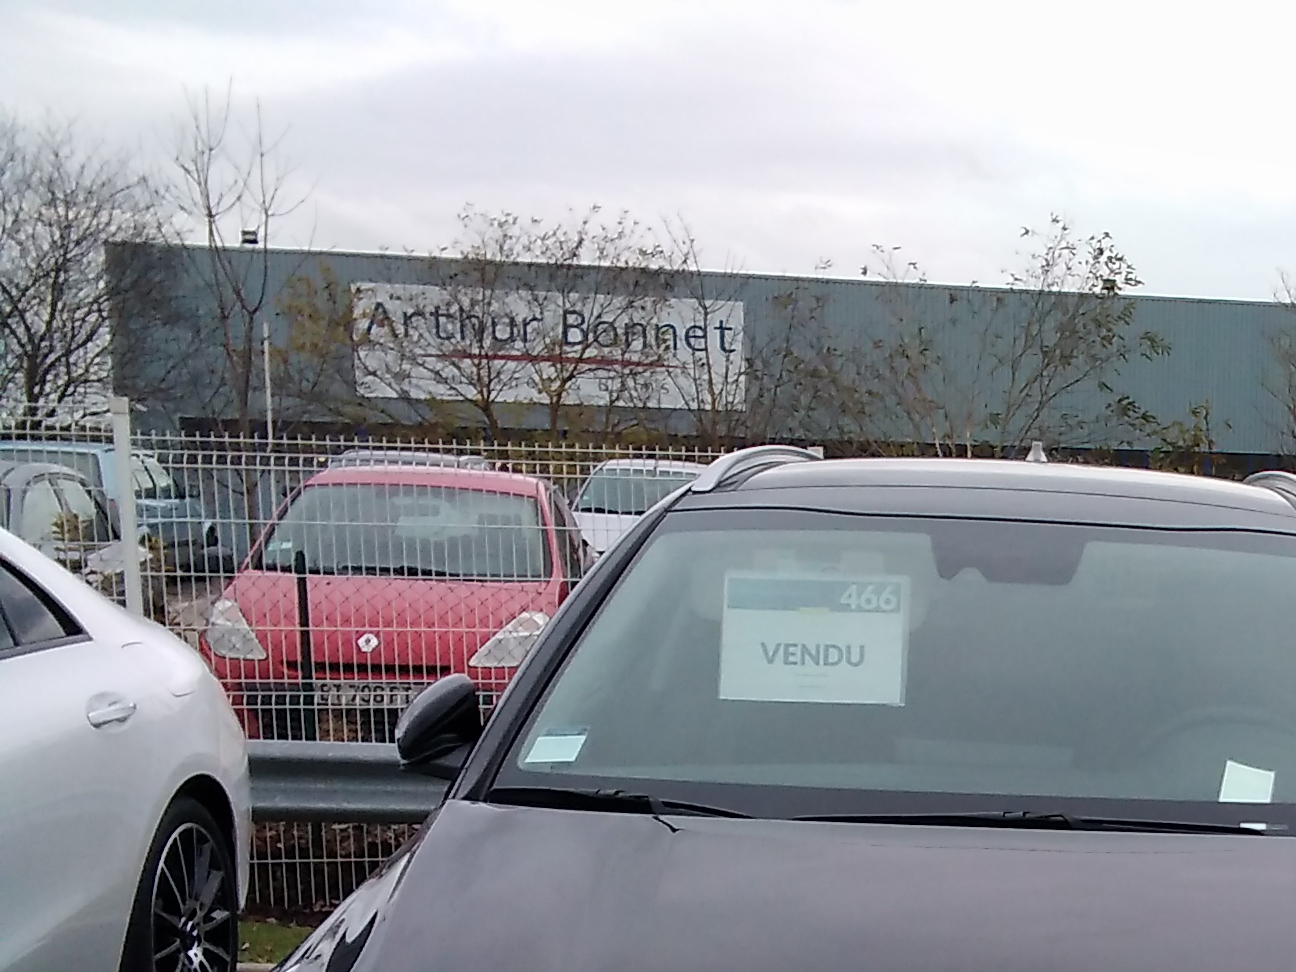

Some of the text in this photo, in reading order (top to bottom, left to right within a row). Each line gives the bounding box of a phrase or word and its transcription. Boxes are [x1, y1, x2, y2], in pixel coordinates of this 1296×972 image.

[366, 302, 737, 354] Arthur Bonnet
[840, 585, 897, 611] 466
[760, 642, 865, 667] VENDU
